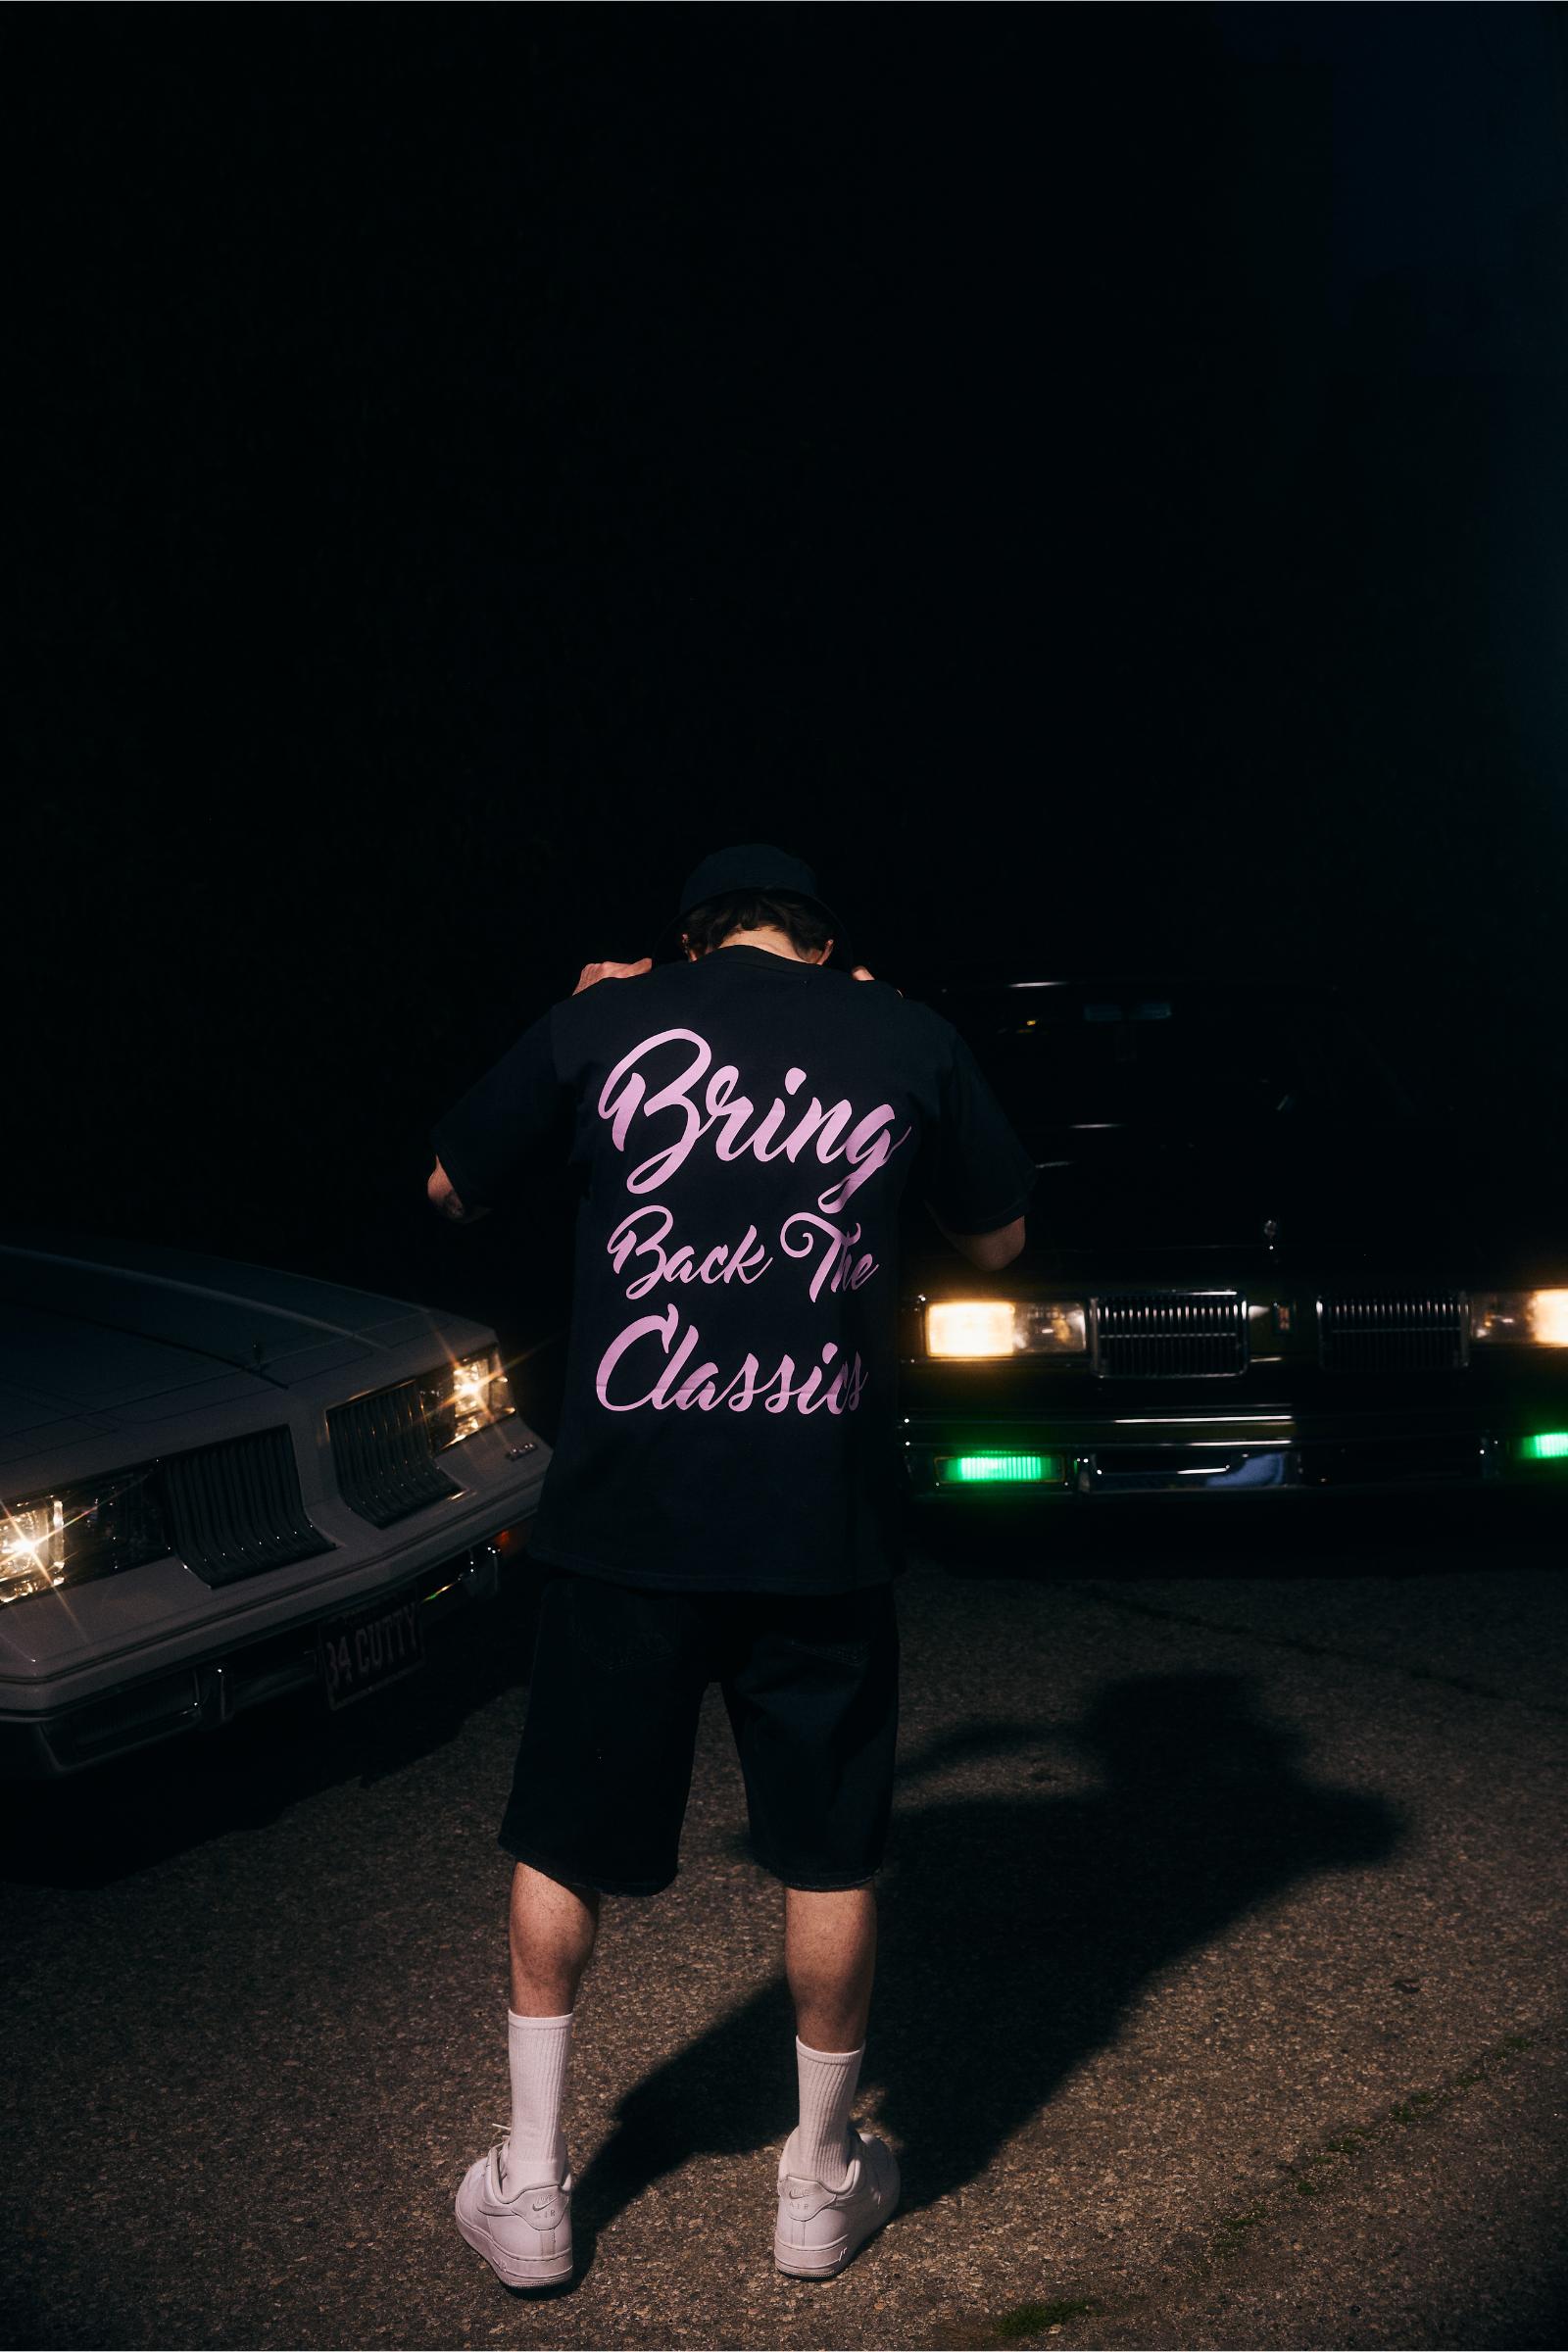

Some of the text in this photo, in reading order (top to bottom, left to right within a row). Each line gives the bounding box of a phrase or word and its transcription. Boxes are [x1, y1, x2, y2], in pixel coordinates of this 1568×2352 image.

[597, 1028, 910, 1214] Bring
[607, 1204, 880, 1303] Back The
[596, 1302, 869, 1416] Classics
[354, 1601, 417, 1678] CUTTY
